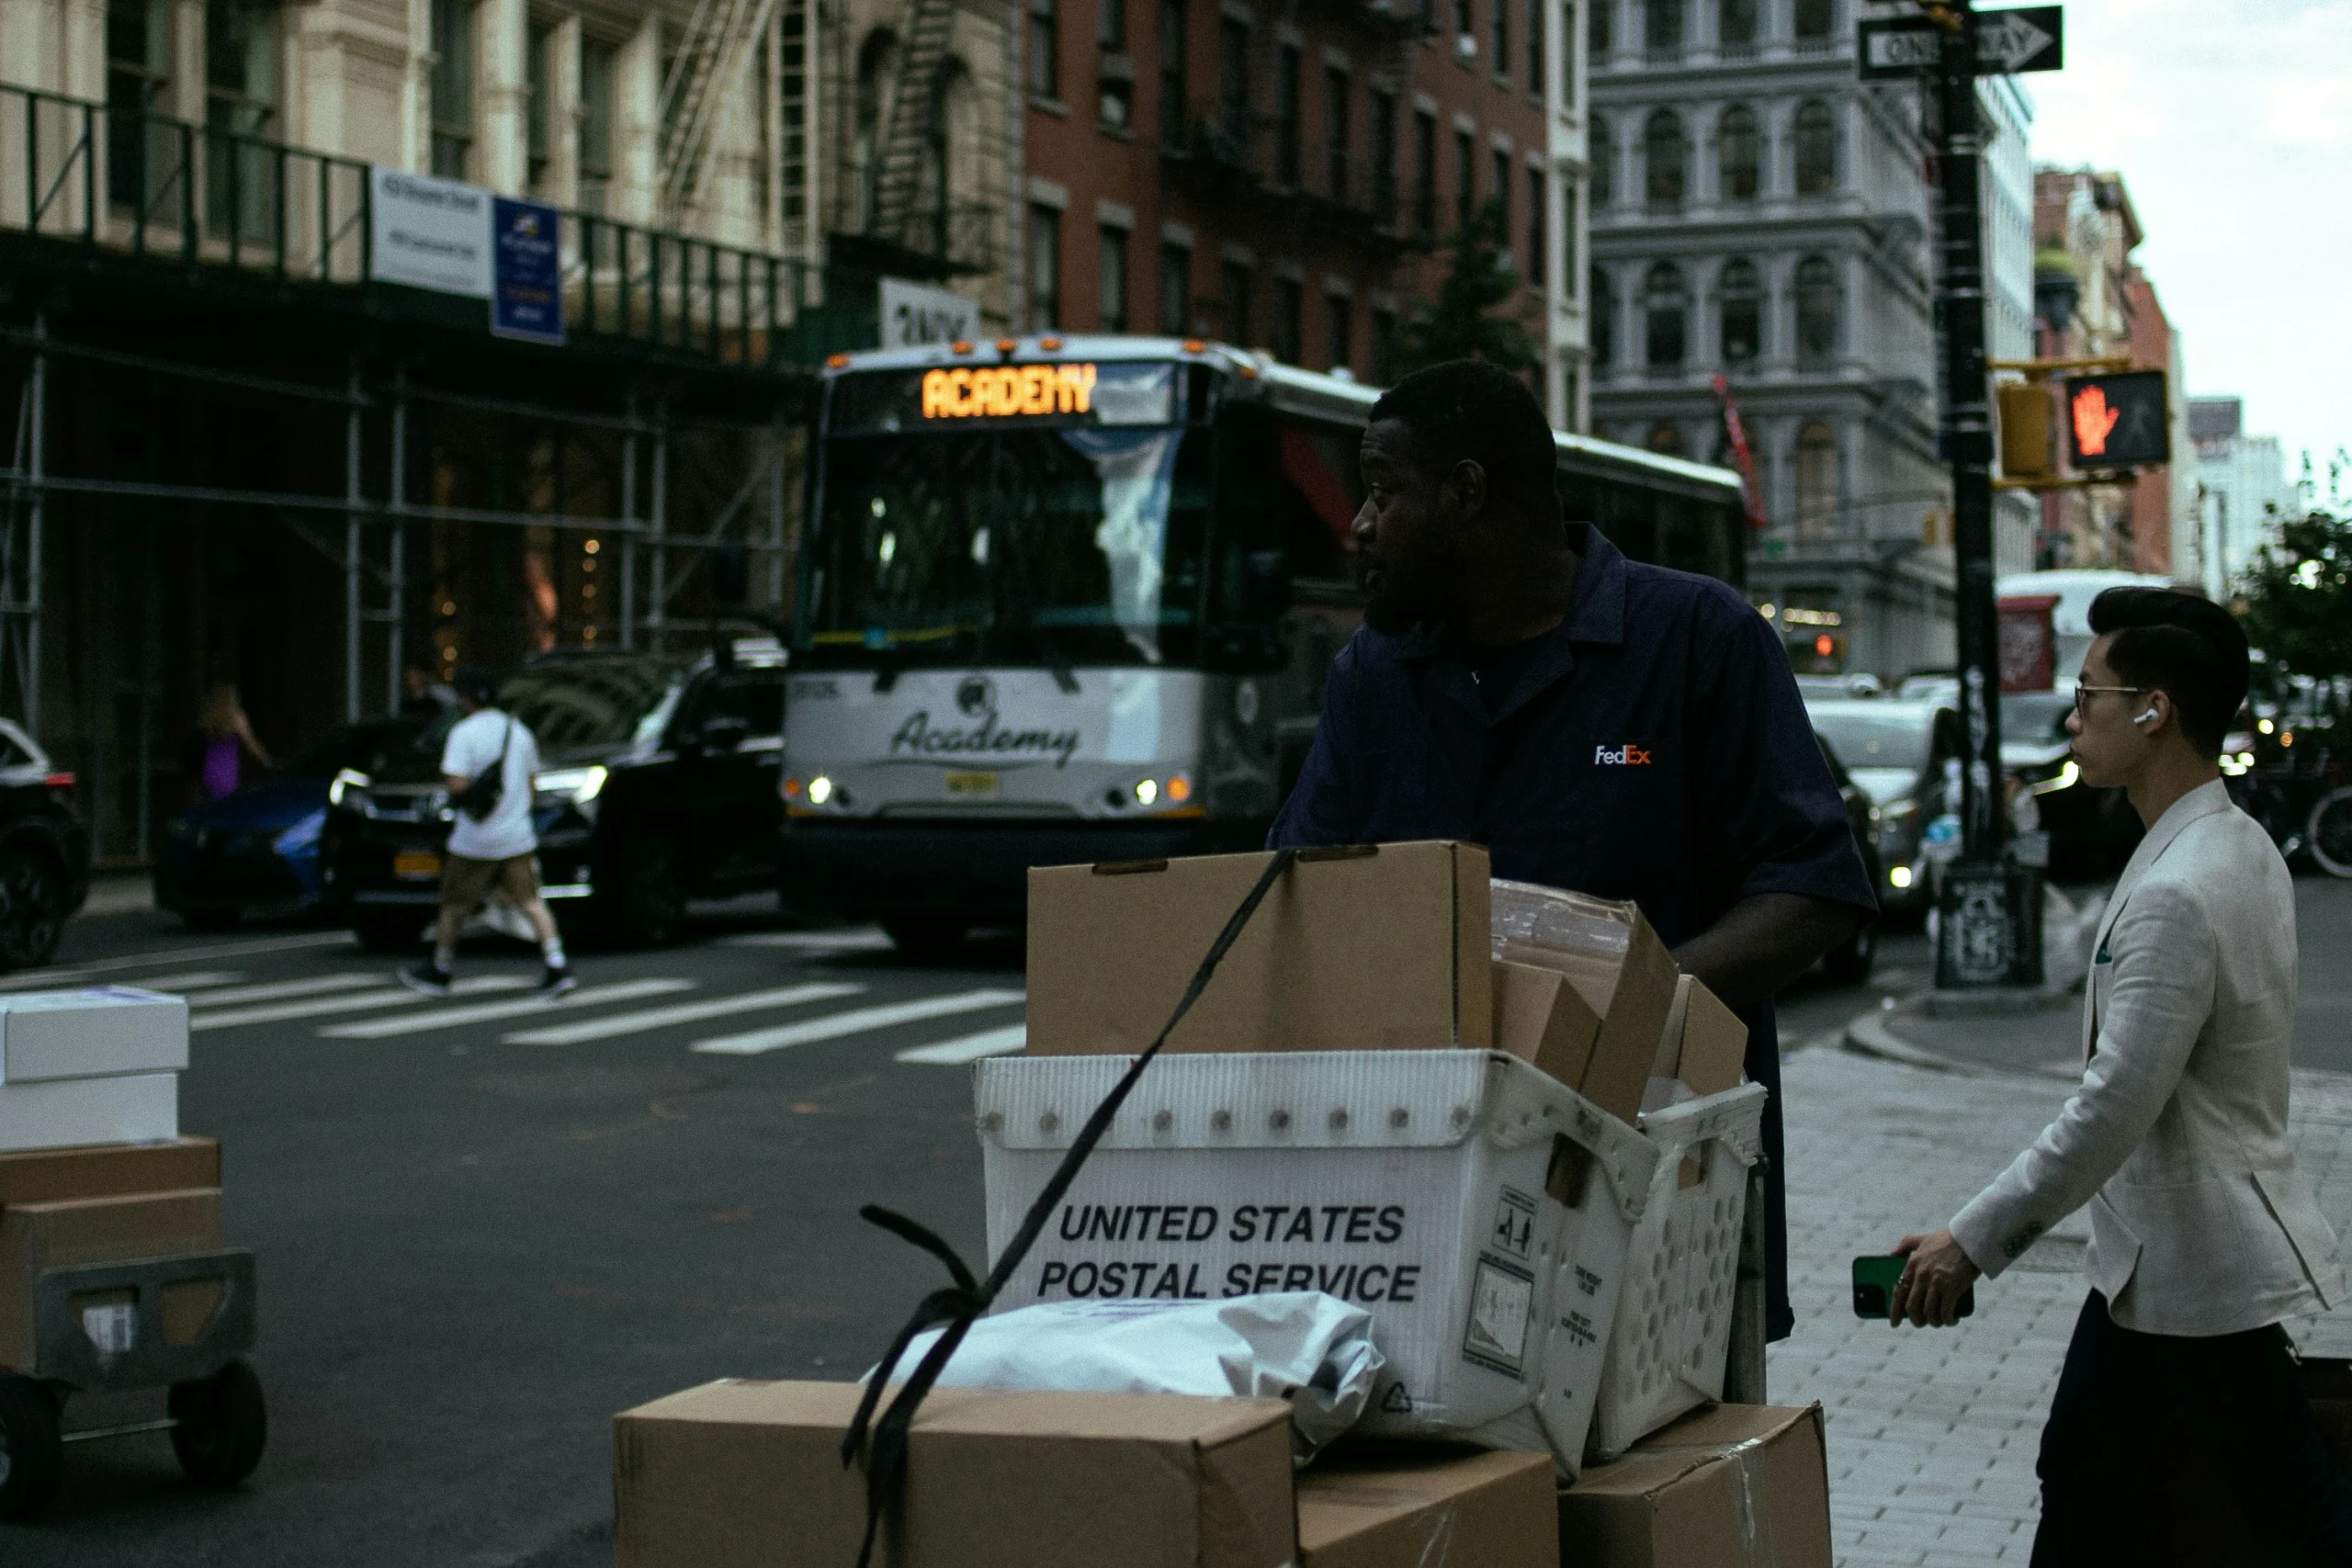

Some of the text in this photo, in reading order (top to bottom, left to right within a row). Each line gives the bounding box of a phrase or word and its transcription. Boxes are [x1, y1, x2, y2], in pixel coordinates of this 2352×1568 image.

[922, 363, 1097, 419] ACADEMY
[891, 709, 1080, 769] Academy
[1595, 745, 1651, 764] FedEx
[1059, 1205, 1405, 1243] UNITED STATES
[1037, 1261, 1207, 1299] POSTAL
